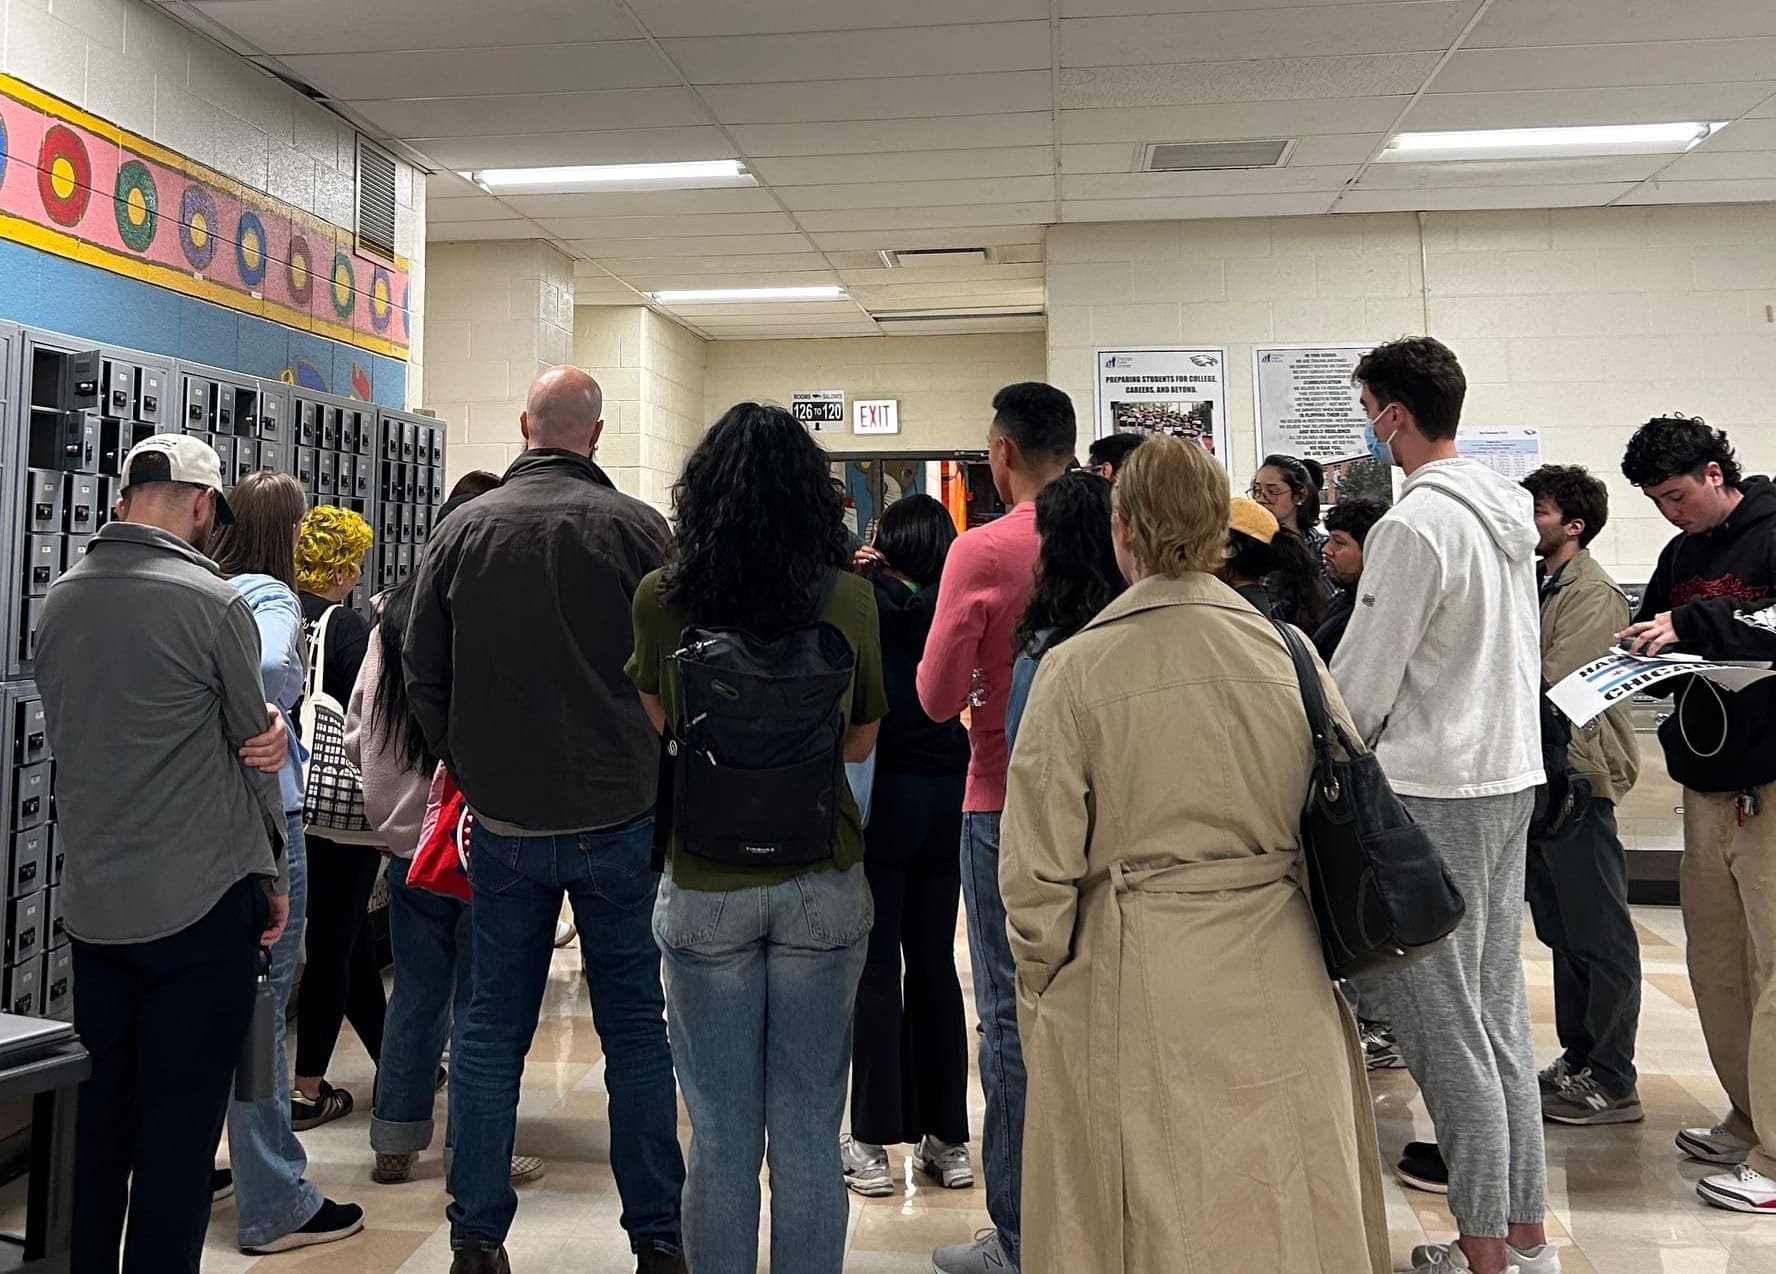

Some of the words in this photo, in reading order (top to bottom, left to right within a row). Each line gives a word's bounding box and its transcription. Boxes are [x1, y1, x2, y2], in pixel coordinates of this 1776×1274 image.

[794, 403, 813, 420] 126
[813, 407, 822, 416] TO
[822, 403, 842, 420] 120
[860, 405, 890, 427] EXIT
